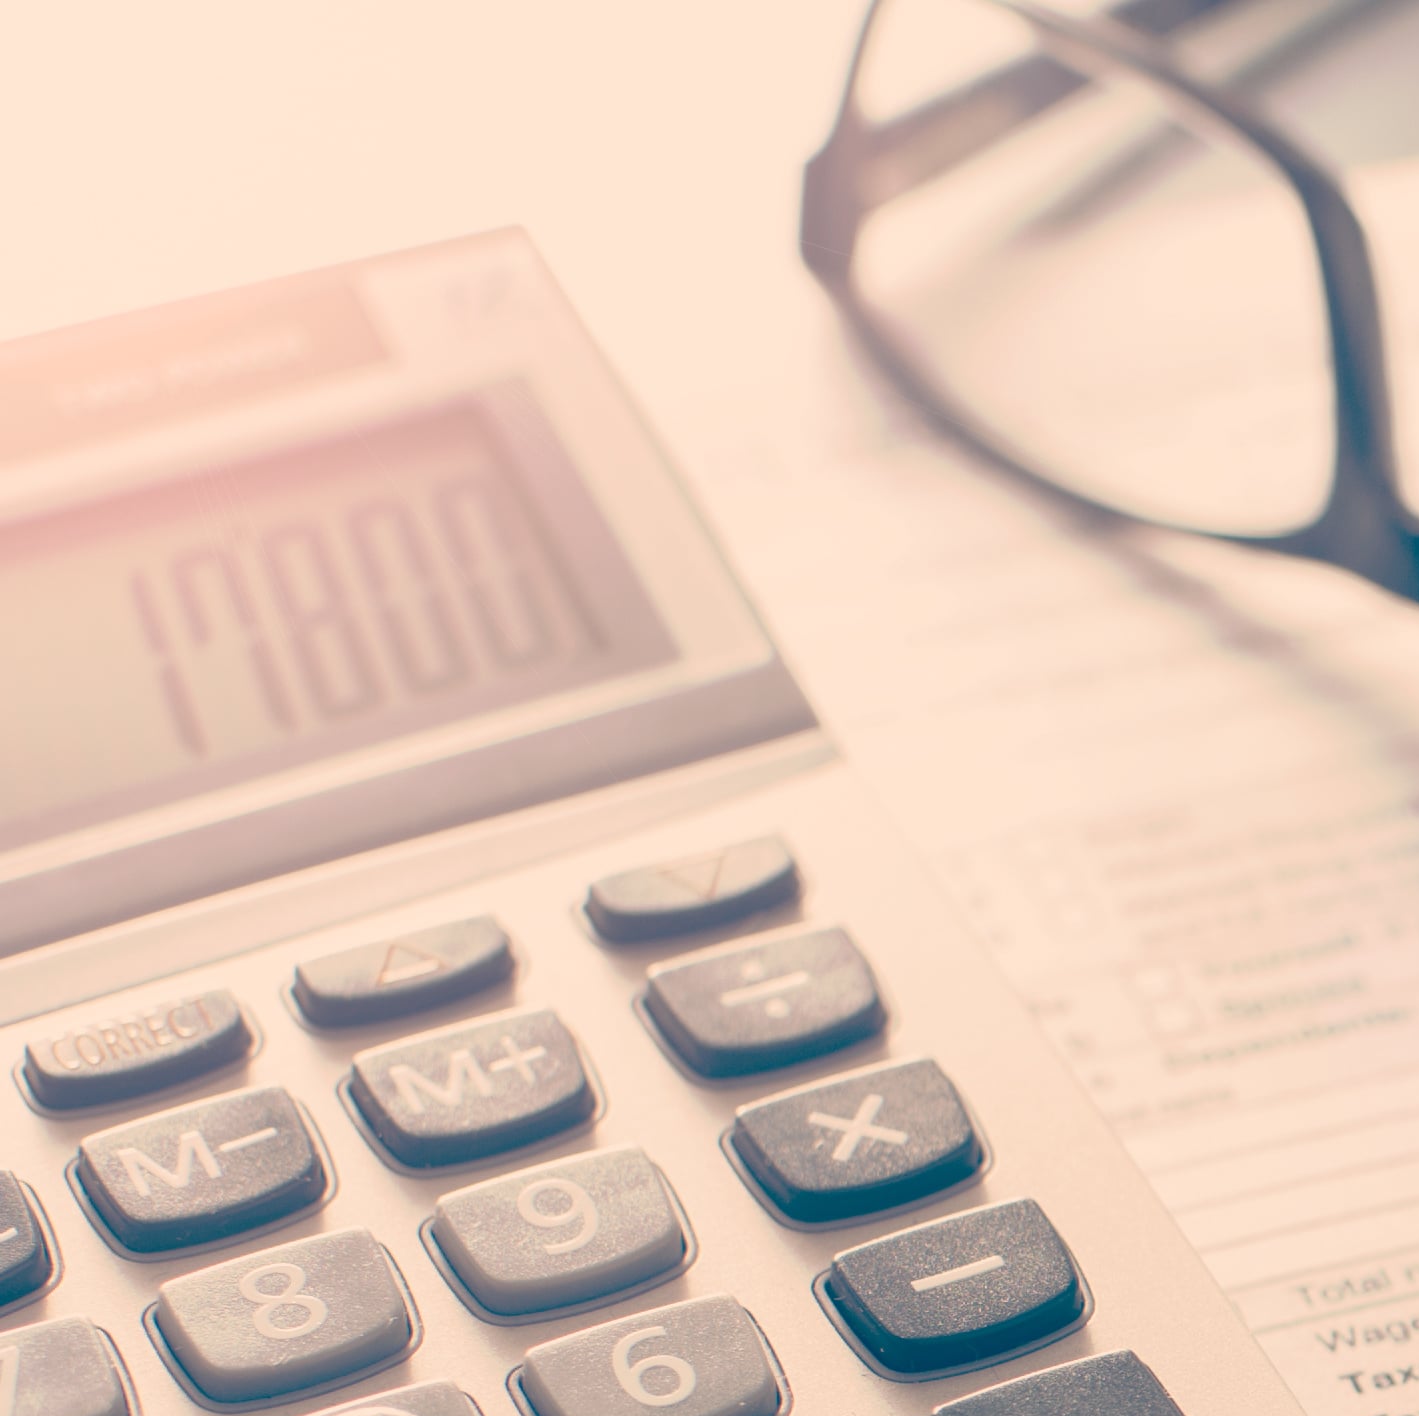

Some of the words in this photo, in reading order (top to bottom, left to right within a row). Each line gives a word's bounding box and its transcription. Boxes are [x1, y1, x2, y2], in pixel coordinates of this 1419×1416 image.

[389, 1035, 547, 1115] M+
[517, 1177, 599, 1255] 9
[238, 1262, 330, 1340] 8
[611, 1326, 698, 1407] 6
